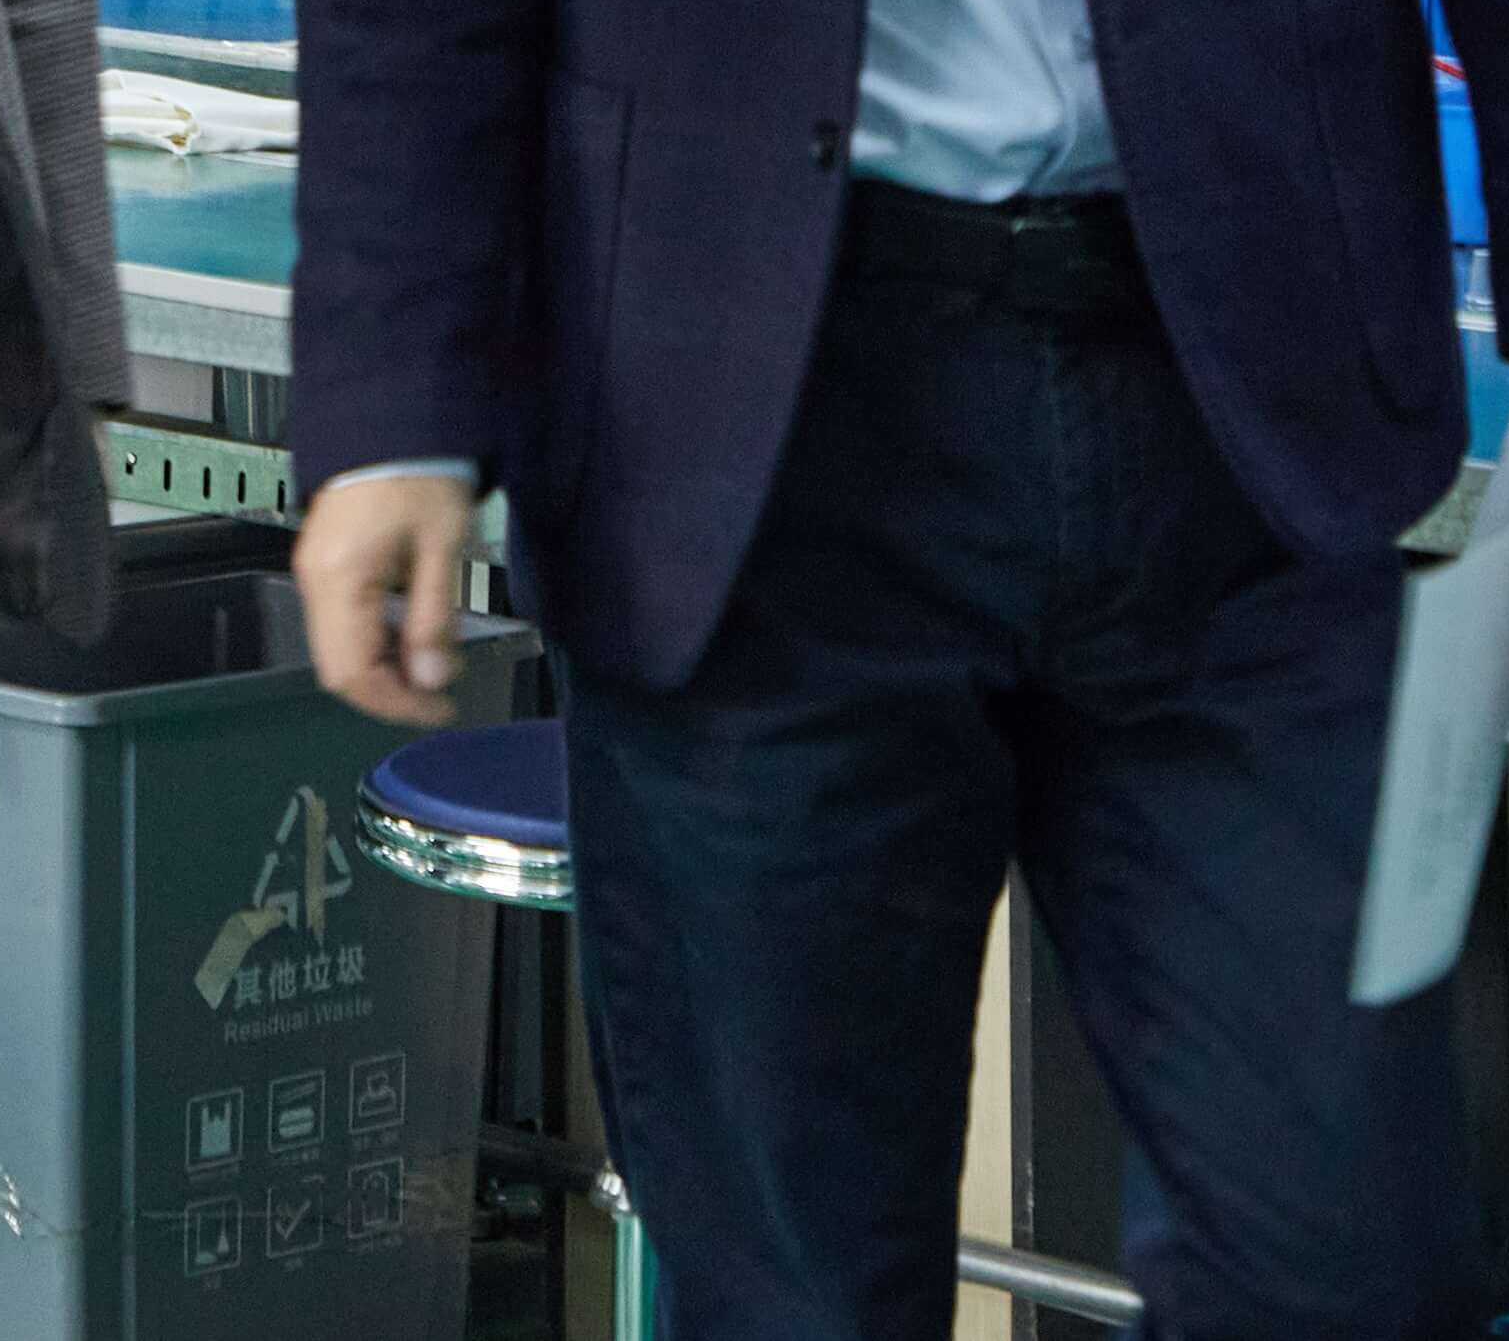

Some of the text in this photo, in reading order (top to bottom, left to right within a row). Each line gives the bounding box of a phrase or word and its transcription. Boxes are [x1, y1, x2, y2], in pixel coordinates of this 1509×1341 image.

[235, 944, 366, 1009] 其他垃圾
[224, 996, 374, 1044] Residual Waste
